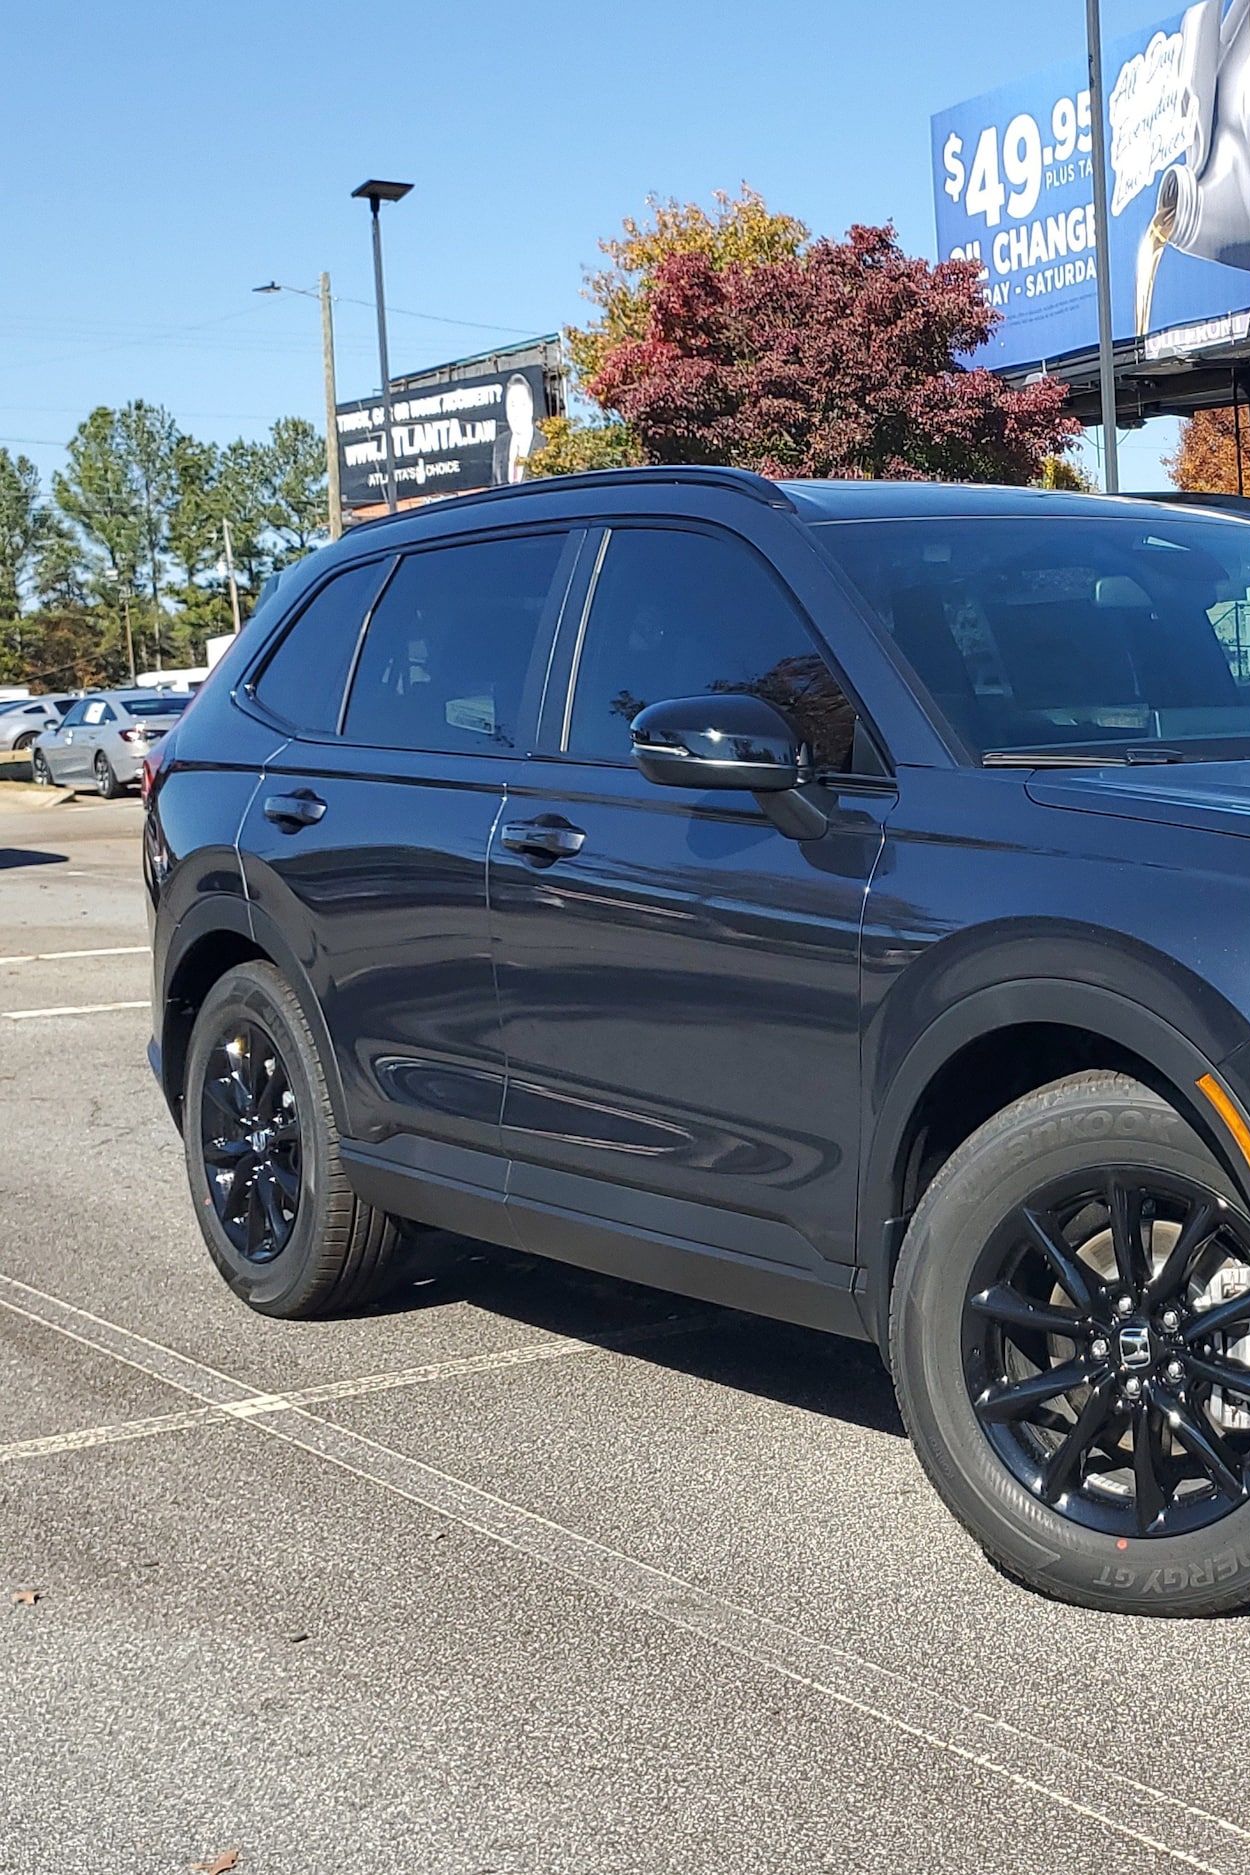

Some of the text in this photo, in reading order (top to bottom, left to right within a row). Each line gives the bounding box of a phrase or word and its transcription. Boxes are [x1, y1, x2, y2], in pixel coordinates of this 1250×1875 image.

[1146, 40, 1176, 85] Day
[1115, 84, 1178, 161] Everyday
[1045, 158, 1094, 191] PLUS TA
[992, 203, 1097, 276] CHANGE
[1025, 256, 1098, 298] SATURDA
[425, 460, 461, 477] CHOICE
[1093, 1565, 1137, 1588] GT
